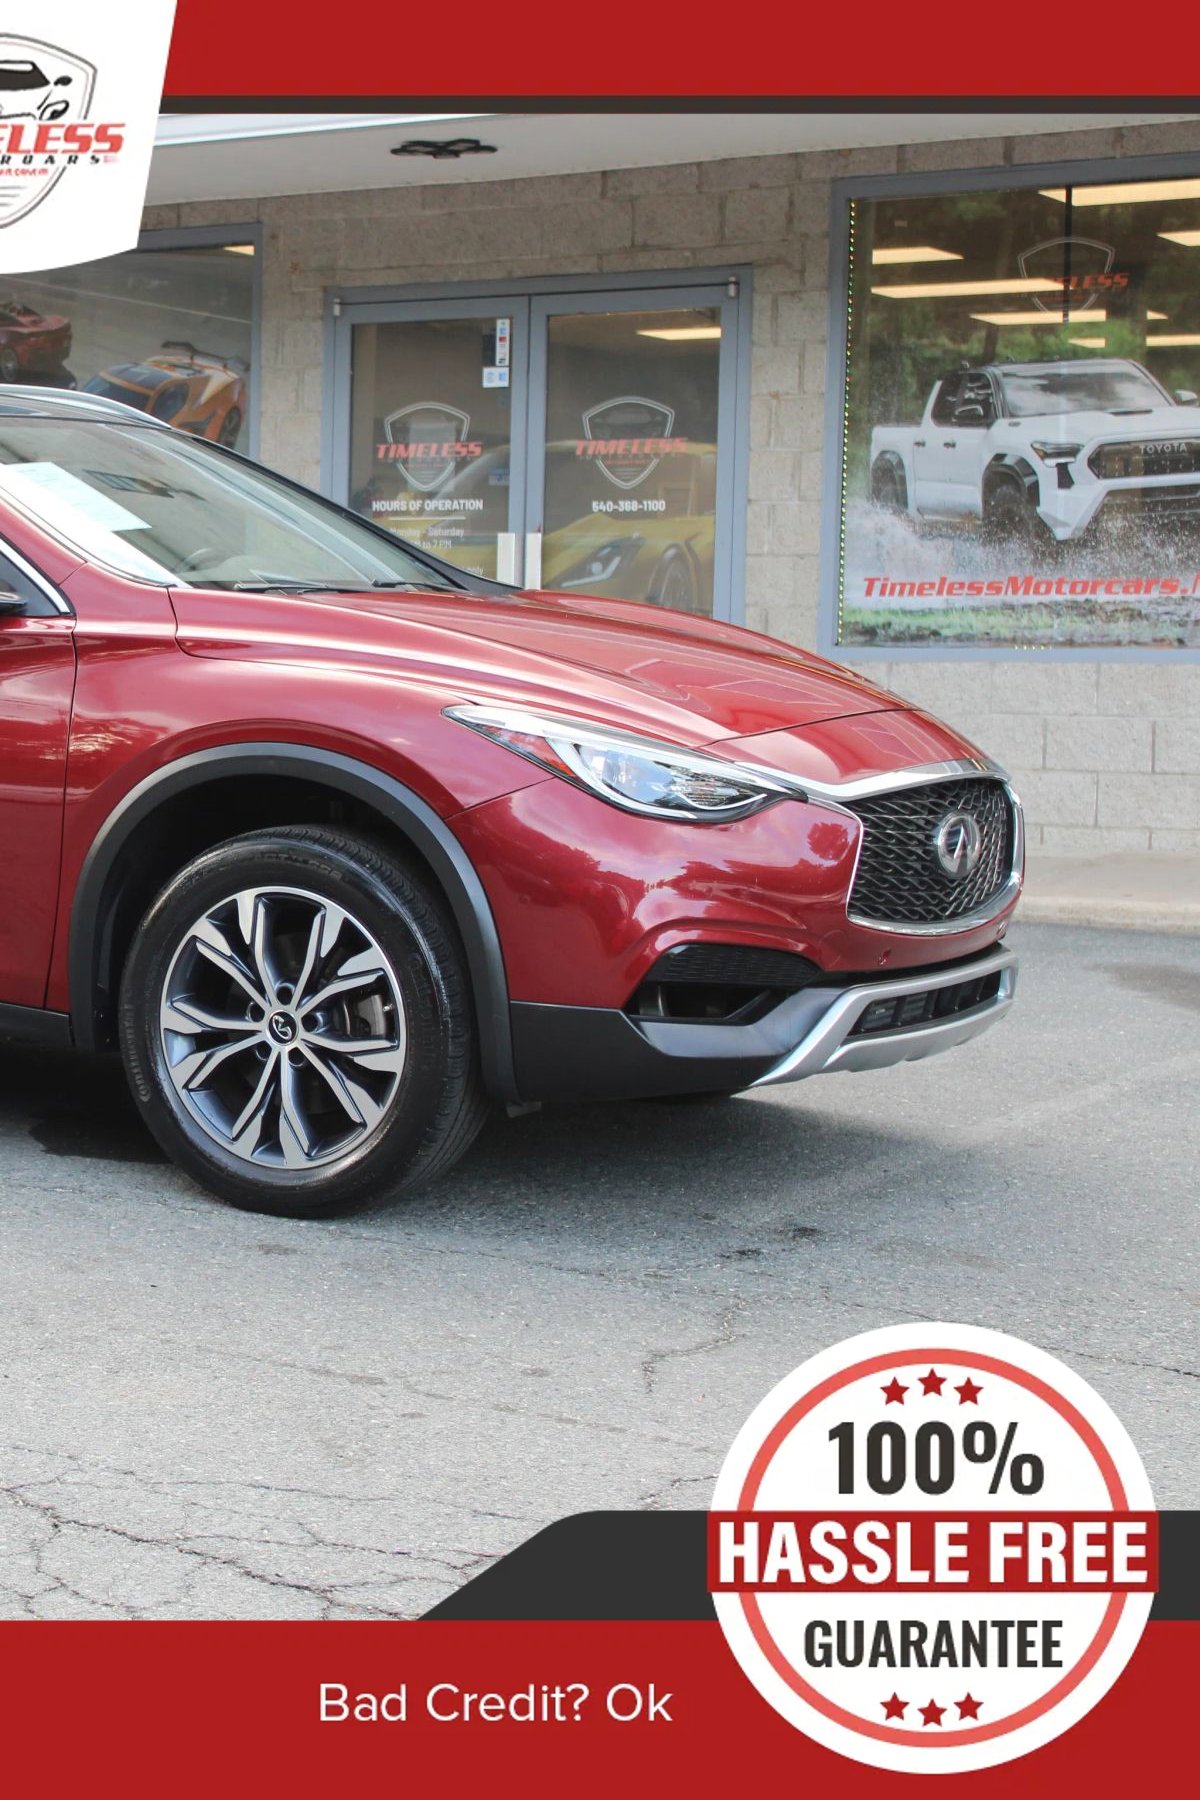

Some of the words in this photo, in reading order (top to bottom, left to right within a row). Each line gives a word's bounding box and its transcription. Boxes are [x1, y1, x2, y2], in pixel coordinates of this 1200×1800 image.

[376, 441, 482, 459] TIMELESS
[576, 437, 688, 456] TIMELESS
[1140, 442, 1188, 454] TOYOTA
[372, 501, 407, 512] HOURS
[409, 501, 422, 511] OF
[424, 499, 484, 511] OPERATION
[592, 500, 666, 512] 540-368-1100
[428, 527, 464, 540] Saturday
